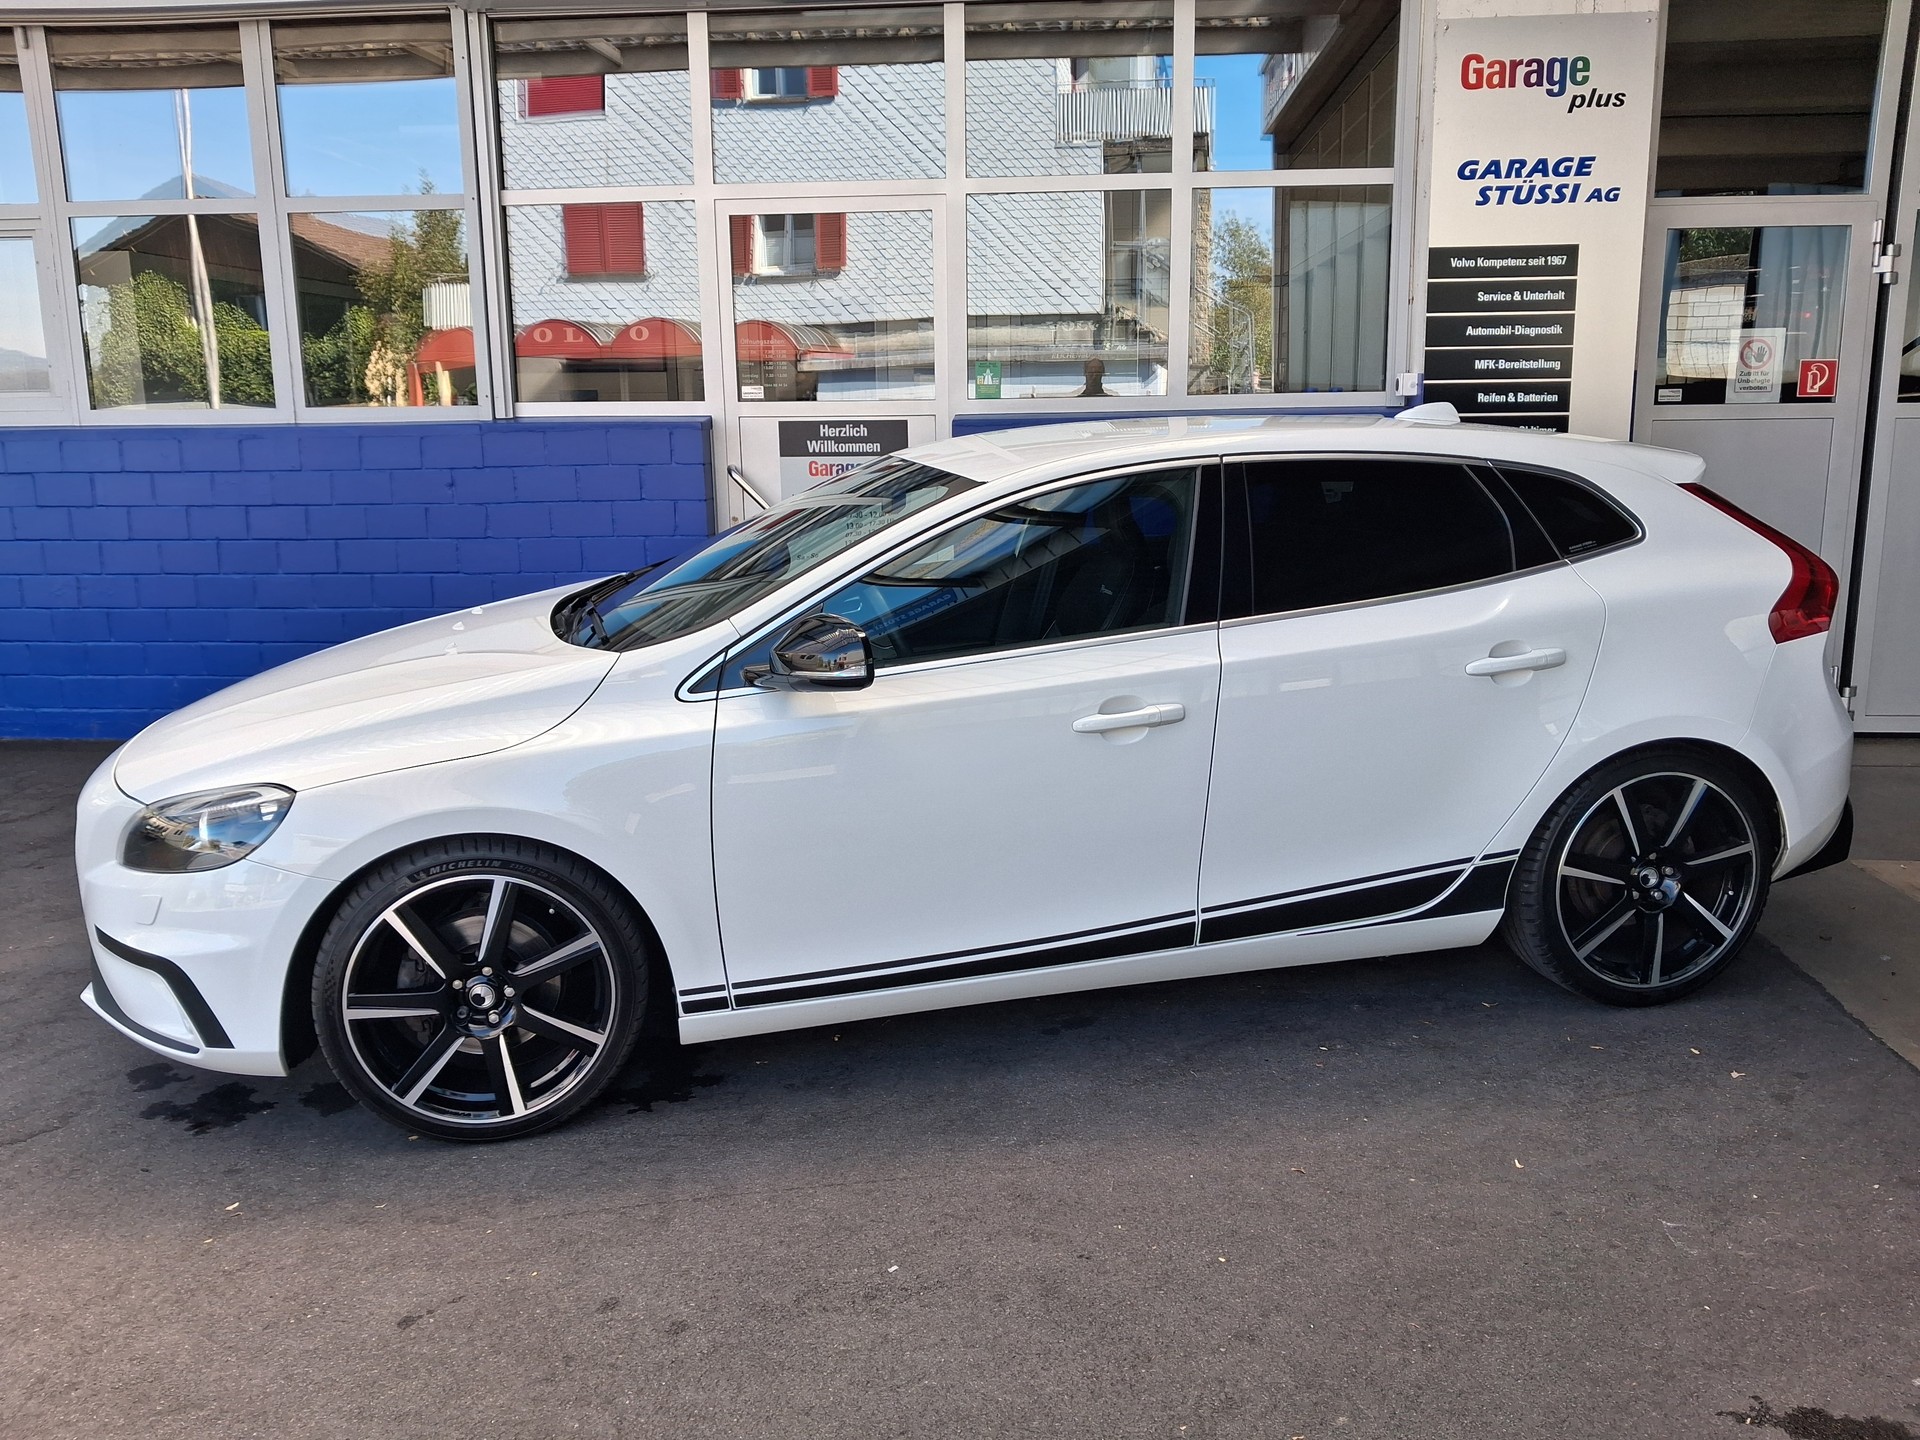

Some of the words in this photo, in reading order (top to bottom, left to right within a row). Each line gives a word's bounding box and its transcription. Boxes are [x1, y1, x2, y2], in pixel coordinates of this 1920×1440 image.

[1461, 53, 1591, 98] Garage
[1567, 87, 1627, 114] plus
[1457, 156, 1597, 181] GARAGE
[1475, 179, 1582, 206] STÜSSI
[1584, 187, 1621, 203] AG
[1450, 257, 1476, 268] Volvo
[1477, 256, 1527, 269] Kompetenz
[1528, 256, 1545, 266] seit
[1546, 255, 1567, 266] 1967
[1477, 291, 1512, 302] Service
[1513, 291, 1521, 301] &
[1523, 290, 1565, 301] Unterhalt
[1465, 324, 1563, 337] Automobil-Diagnostik
[1474, 359, 1561, 370] MFK-Bereitstellung
[1477, 392, 1506, 403] Reifen
[1507, 392, 1516, 402] &
[1517, 392, 1559, 402] Batterien
[819, 424, 868, 437] Herzlich
[806, 440, 881, 453] Willkommen
[429, 859, 502, 875] MICHELIN
